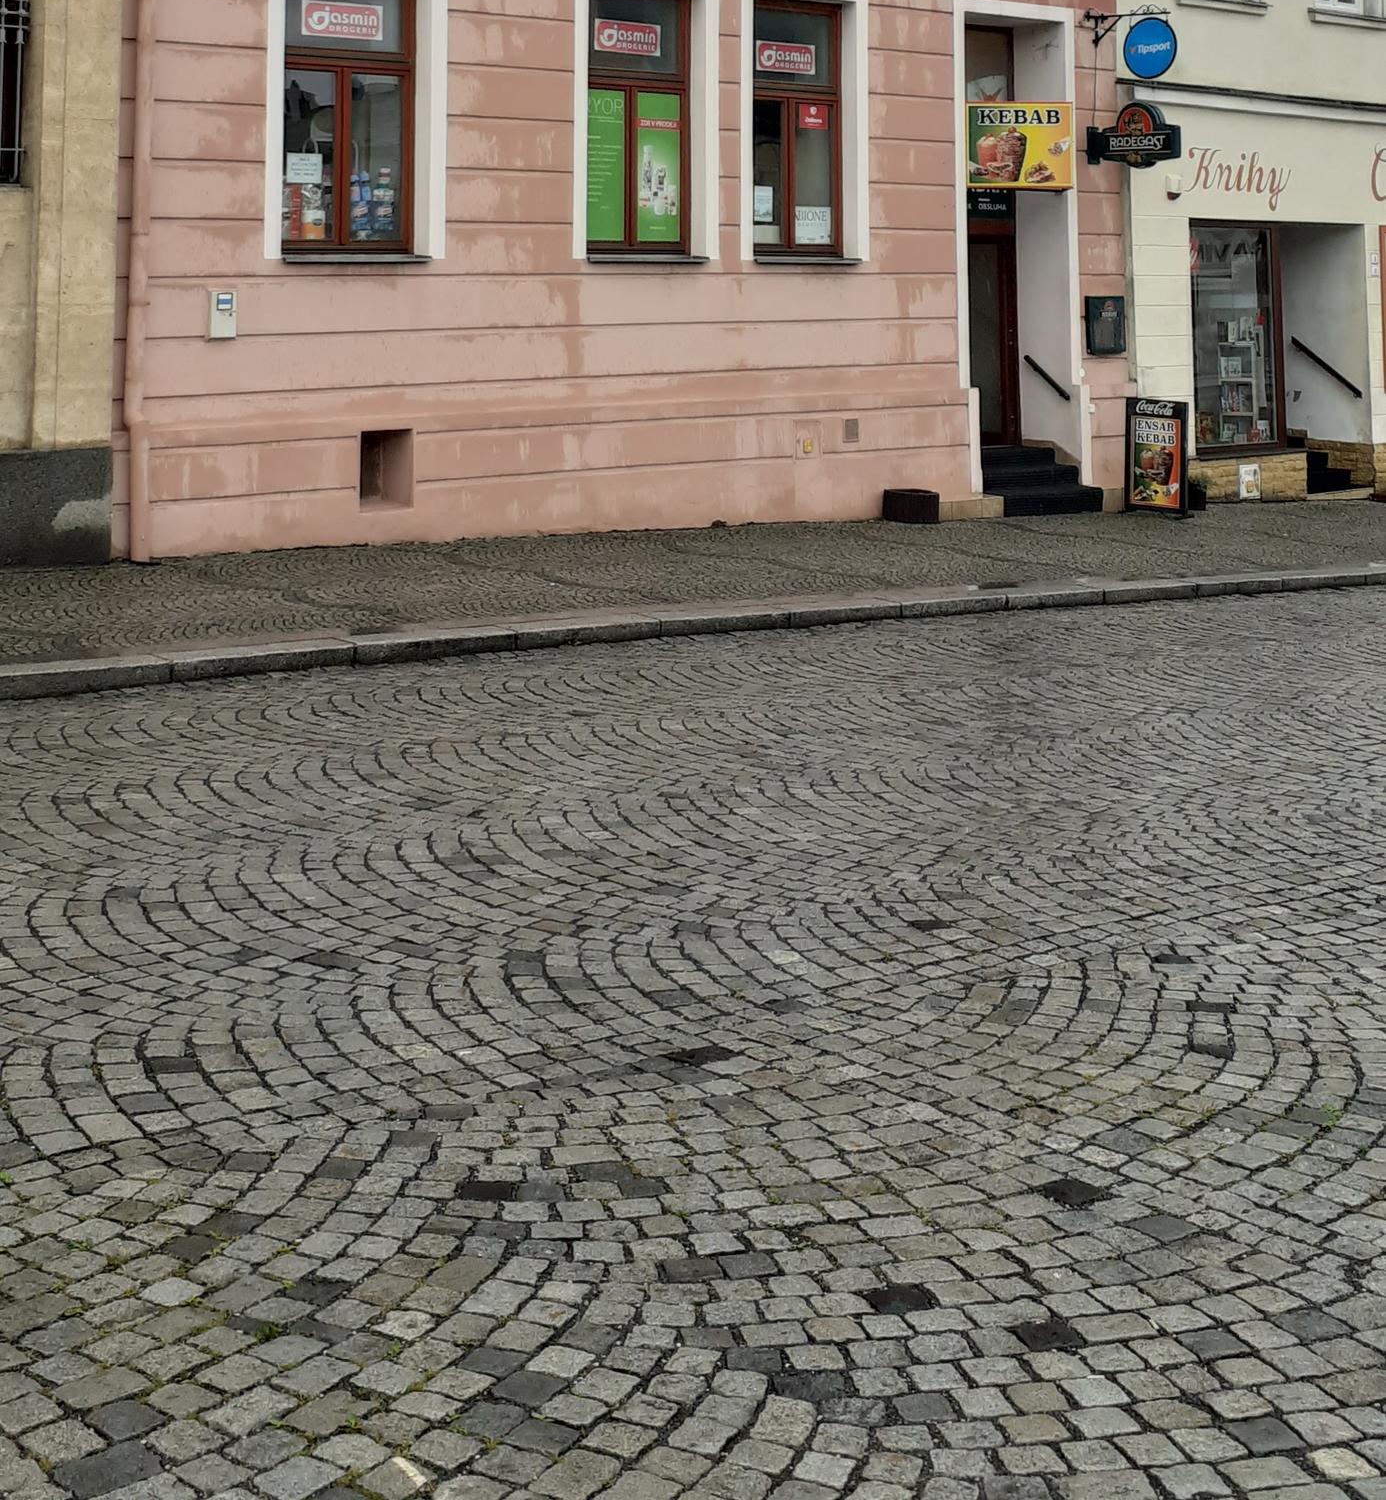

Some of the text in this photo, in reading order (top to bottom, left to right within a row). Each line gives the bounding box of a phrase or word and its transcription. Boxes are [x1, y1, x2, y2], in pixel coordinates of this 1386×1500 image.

[328, 24, 377, 35] DROGERIE
[1137, 41, 1171, 55] Tipsport
[978, 109, 1061, 125] KEBAB
[1109, 135, 1166, 152] RADEGAST
[1184, 147, 1292, 212] Knihy
[1137, 419, 1175, 432] ENSAR
[1137, 432, 1175, 445] KEBAB
